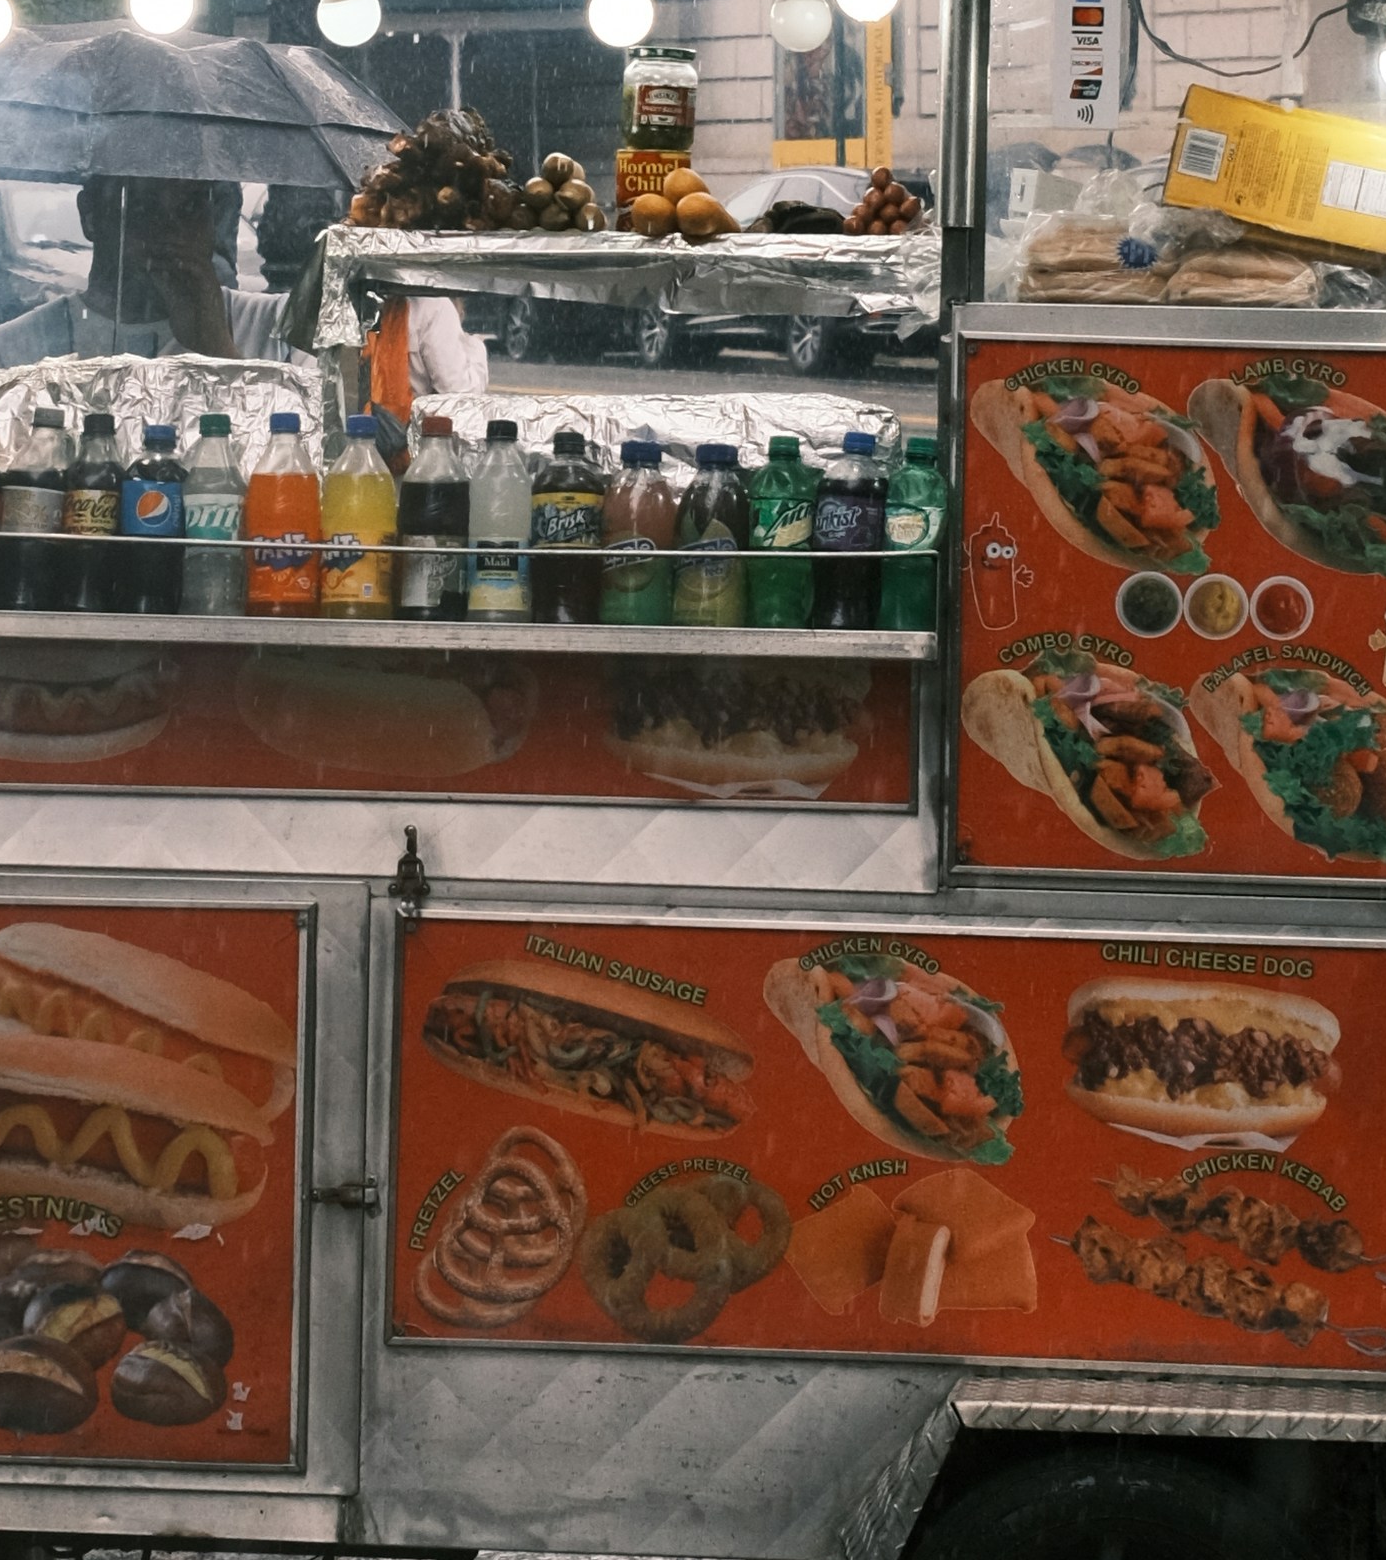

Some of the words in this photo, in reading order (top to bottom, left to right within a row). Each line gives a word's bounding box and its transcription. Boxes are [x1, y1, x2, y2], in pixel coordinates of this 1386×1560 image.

[1076, 36, 1099, 45] VISA
[619, 158, 680, 174] Hormel
[625, 175, 666, 193] Chil
[1005, 358, 1085, 393] CHICKEN
[1089, 361, 1141, 397] GYRO
[1230, 357, 1288, 386] LAMB
[1291, 357, 1347, 389] GYRO
[484, 557, 511, 567] Maid
[998, 631, 1073, 666] COMBO
[1079, 633, 1133, 668] GYRO
[1202, 644, 1278, 693] FALAFEL
[1281, 644, 1371, 697] SANDWICH
[525, 934, 605, 975] ITALIAN
[607, 960, 707, 1007] SAUSAGE
[799, 937, 883, 973] CHICKEN
[887, 939, 941, 976] GYRO
[1101, 942, 1159, 966] CHILI
[1165, 946, 1256, 974] CHEESE
[1263, 954, 1314, 979] DOG
[625, 1160, 680, 1207] CHEESE
[683, 1157, 752, 1185] PRETZEL
[808, 1177, 845, 1211] HOT
[847, 1159, 908, 1186] KNISH
[1180, 1152, 1276, 1186] CHICKEN
[1281, 1161, 1348, 1214] KEBAB
[410, 1168, 465, 1251] PRETZEL
